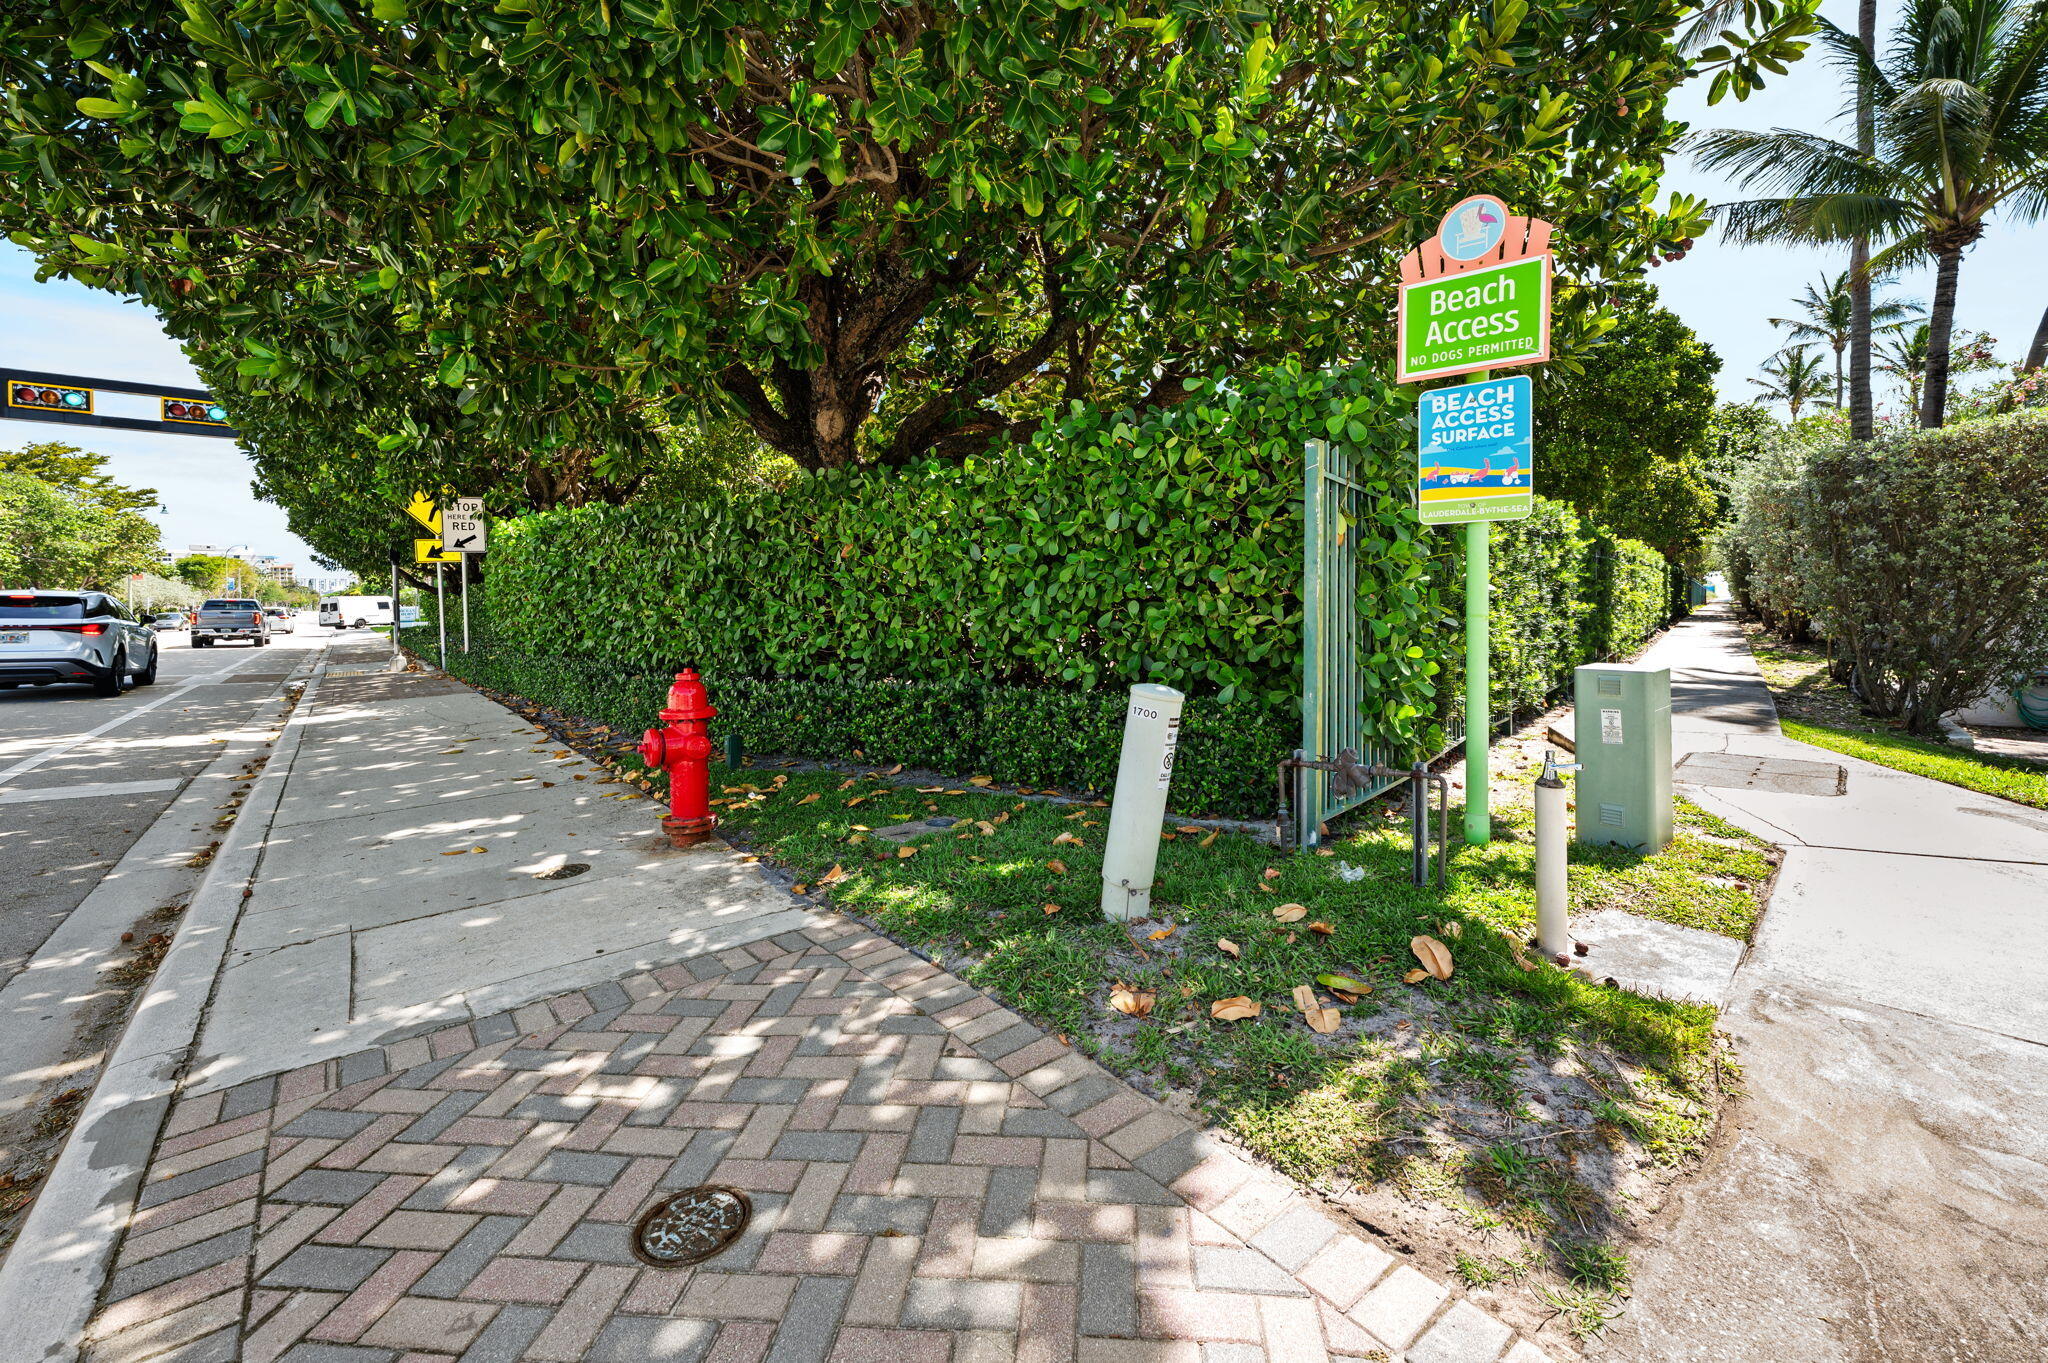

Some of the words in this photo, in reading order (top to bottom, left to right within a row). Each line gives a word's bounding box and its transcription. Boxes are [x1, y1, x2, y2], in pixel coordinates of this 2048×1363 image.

[1430, 274, 1516, 316] Beach
[1425, 309, 1520, 347] Access
[1410, 356, 1426, 367] NO
[1432, 350, 1463, 363] DOGS
[1468, 336, 1534, 358] PERMITTED
[1431, 384, 1515, 413] BEACH
[1431, 407, 1515, 430] ACCESS
[1431, 423, 1515, 446] SURFACE
[452, 522, 476, 531] RED
[1133, 706, 1158, 719] 1700
